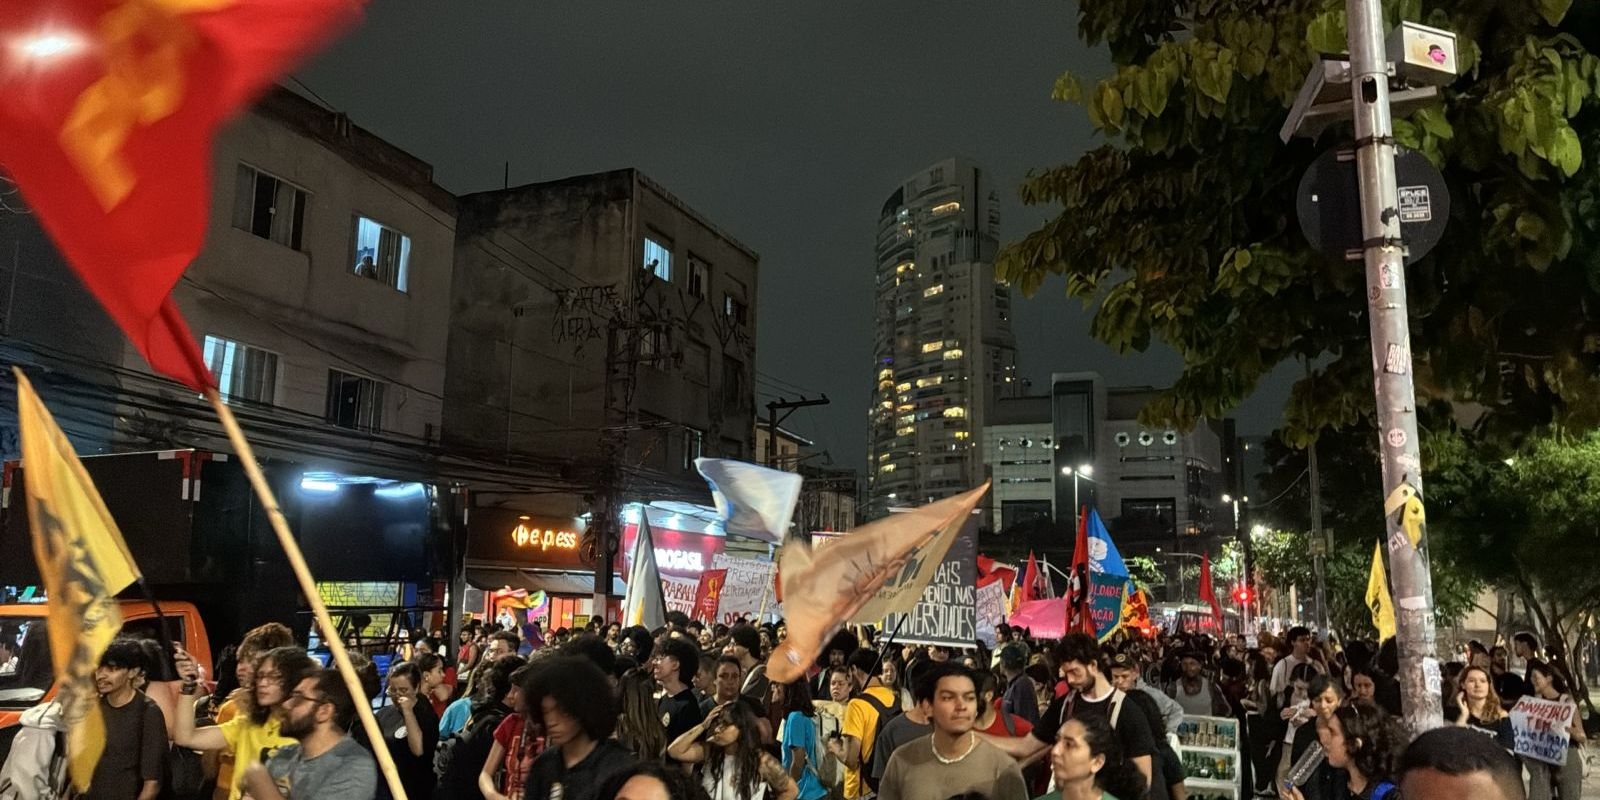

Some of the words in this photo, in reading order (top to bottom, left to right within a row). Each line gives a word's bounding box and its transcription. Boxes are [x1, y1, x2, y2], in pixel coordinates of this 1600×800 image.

[654, 548, 704, 571] ROGASIL
[955, 586, 974, 606] NAS
[1517, 701, 1571, 721] DINHEIRO
[1527, 715, 1552, 732] TEM
